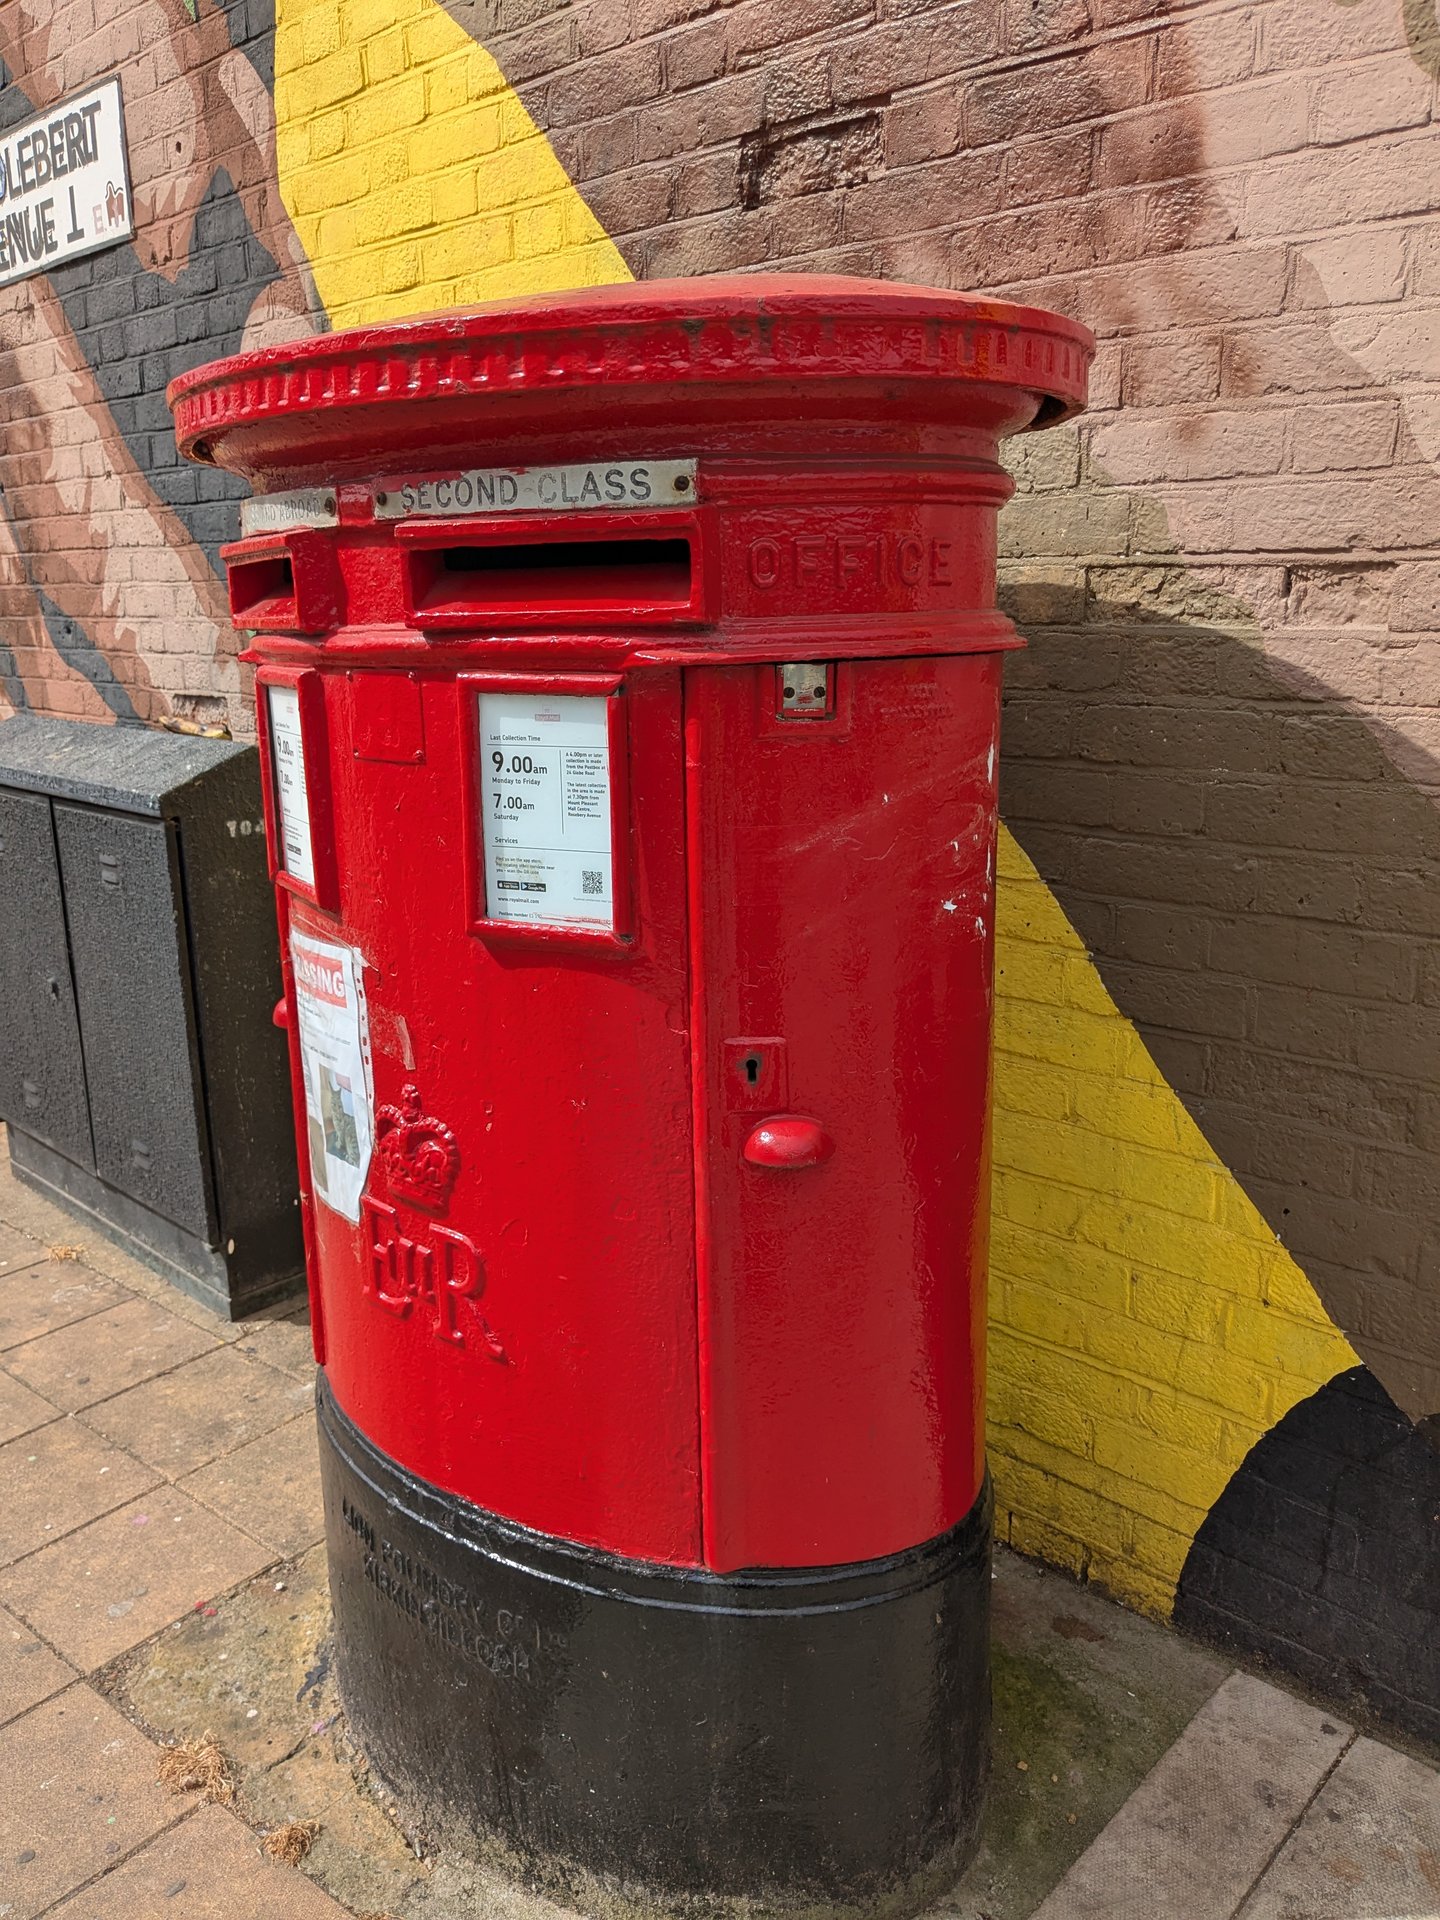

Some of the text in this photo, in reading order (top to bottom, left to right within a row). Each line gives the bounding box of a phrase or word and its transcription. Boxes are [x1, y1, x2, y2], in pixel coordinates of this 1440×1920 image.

[0, 100, 101, 200] LEBERT
[401, 468, 651, 510] SECOND CLASS
[280, 498, 320, 521] ABROAD
[748, 535, 953, 589] OFFICE
[492, 751, 548, 774] 9.00am
[492, 777, 514, 786] Monday
[523, 778, 541, 787] Friday
[493, 793, 535, 810] 7.00am
[494, 813, 520, 822] Saturday
